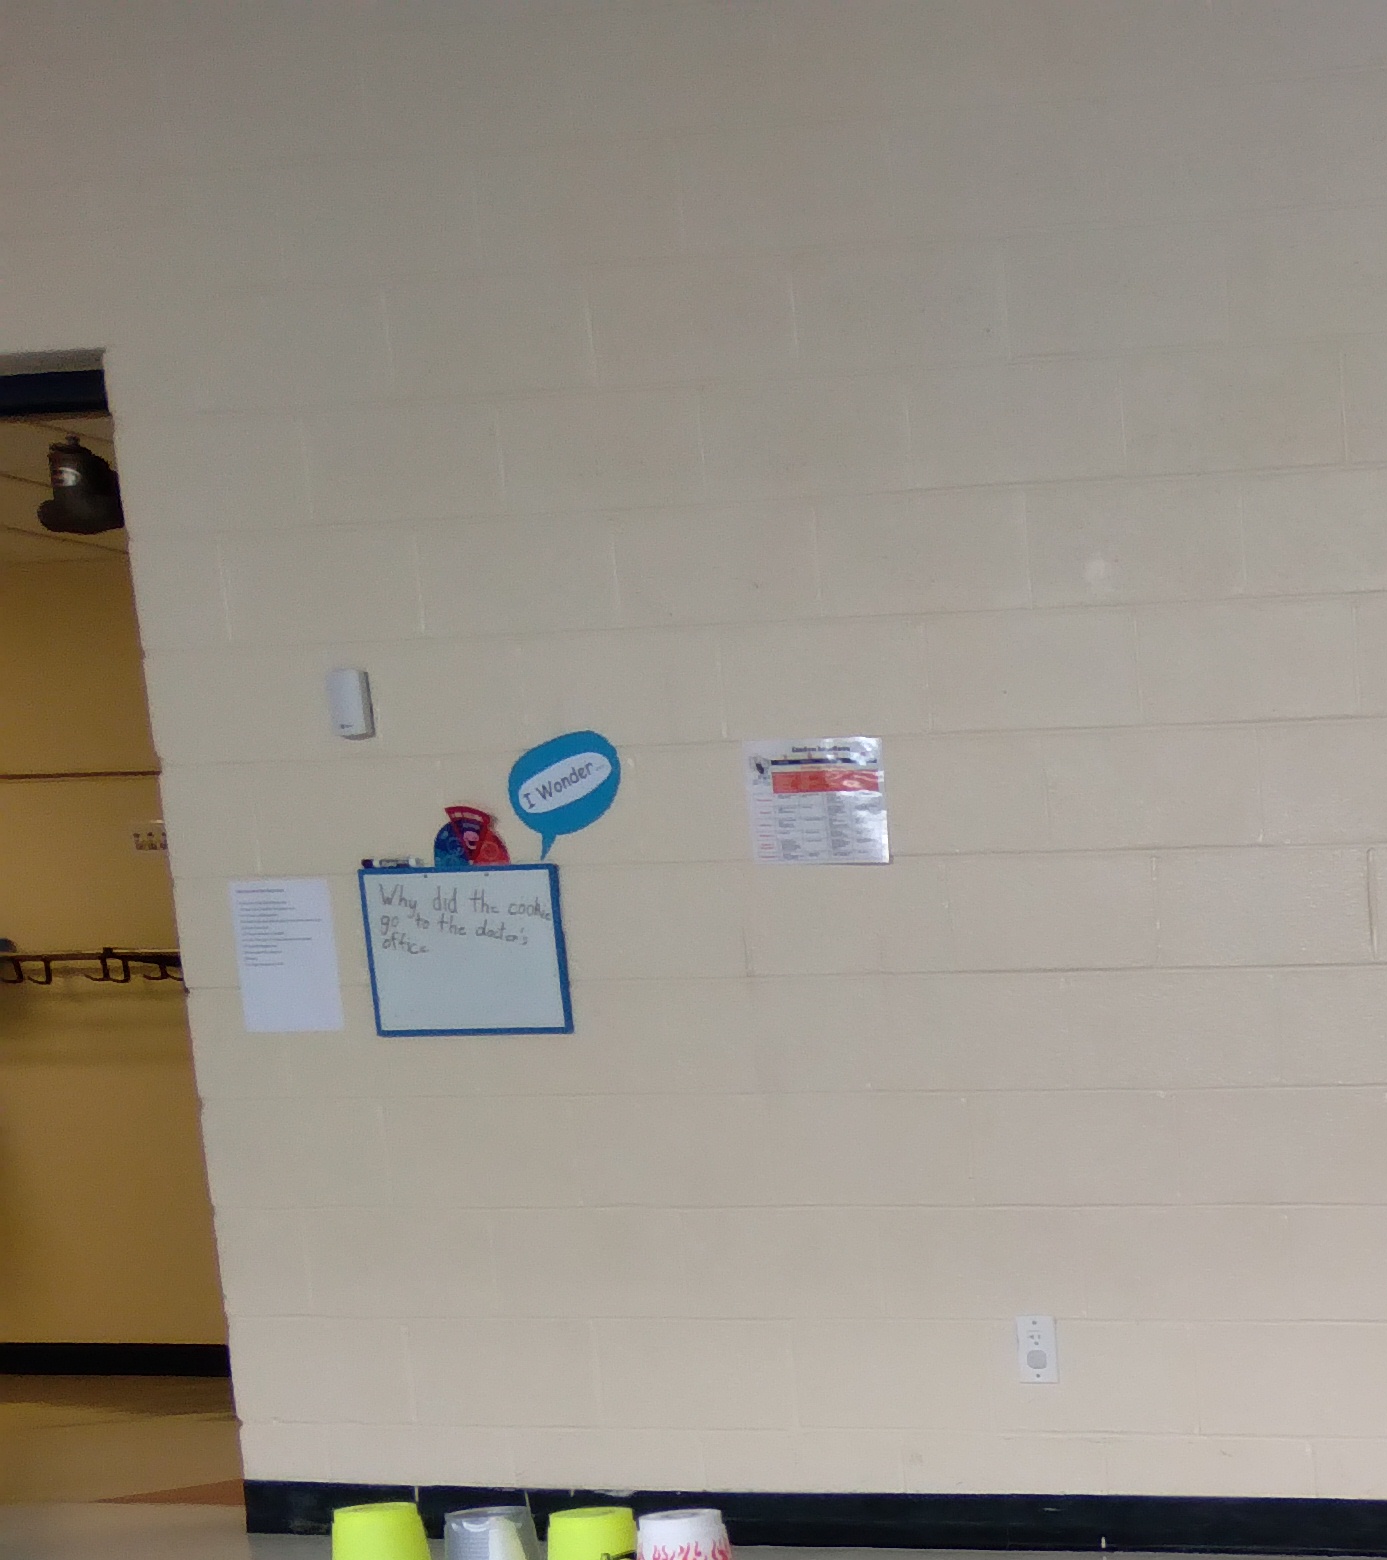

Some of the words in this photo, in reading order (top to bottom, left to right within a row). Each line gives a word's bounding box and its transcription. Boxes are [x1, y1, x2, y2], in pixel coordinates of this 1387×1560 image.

[523, 792, 536, 809] I
[379, 884, 417, 918] Why
[433, 886, 458, 914] did
[470, 889, 499, 914] the
[380, 914, 398, 935] go
[415, 914, 429, 930] to
[438, 913, 467, 936] the
[382, 932, 429, 954] office
